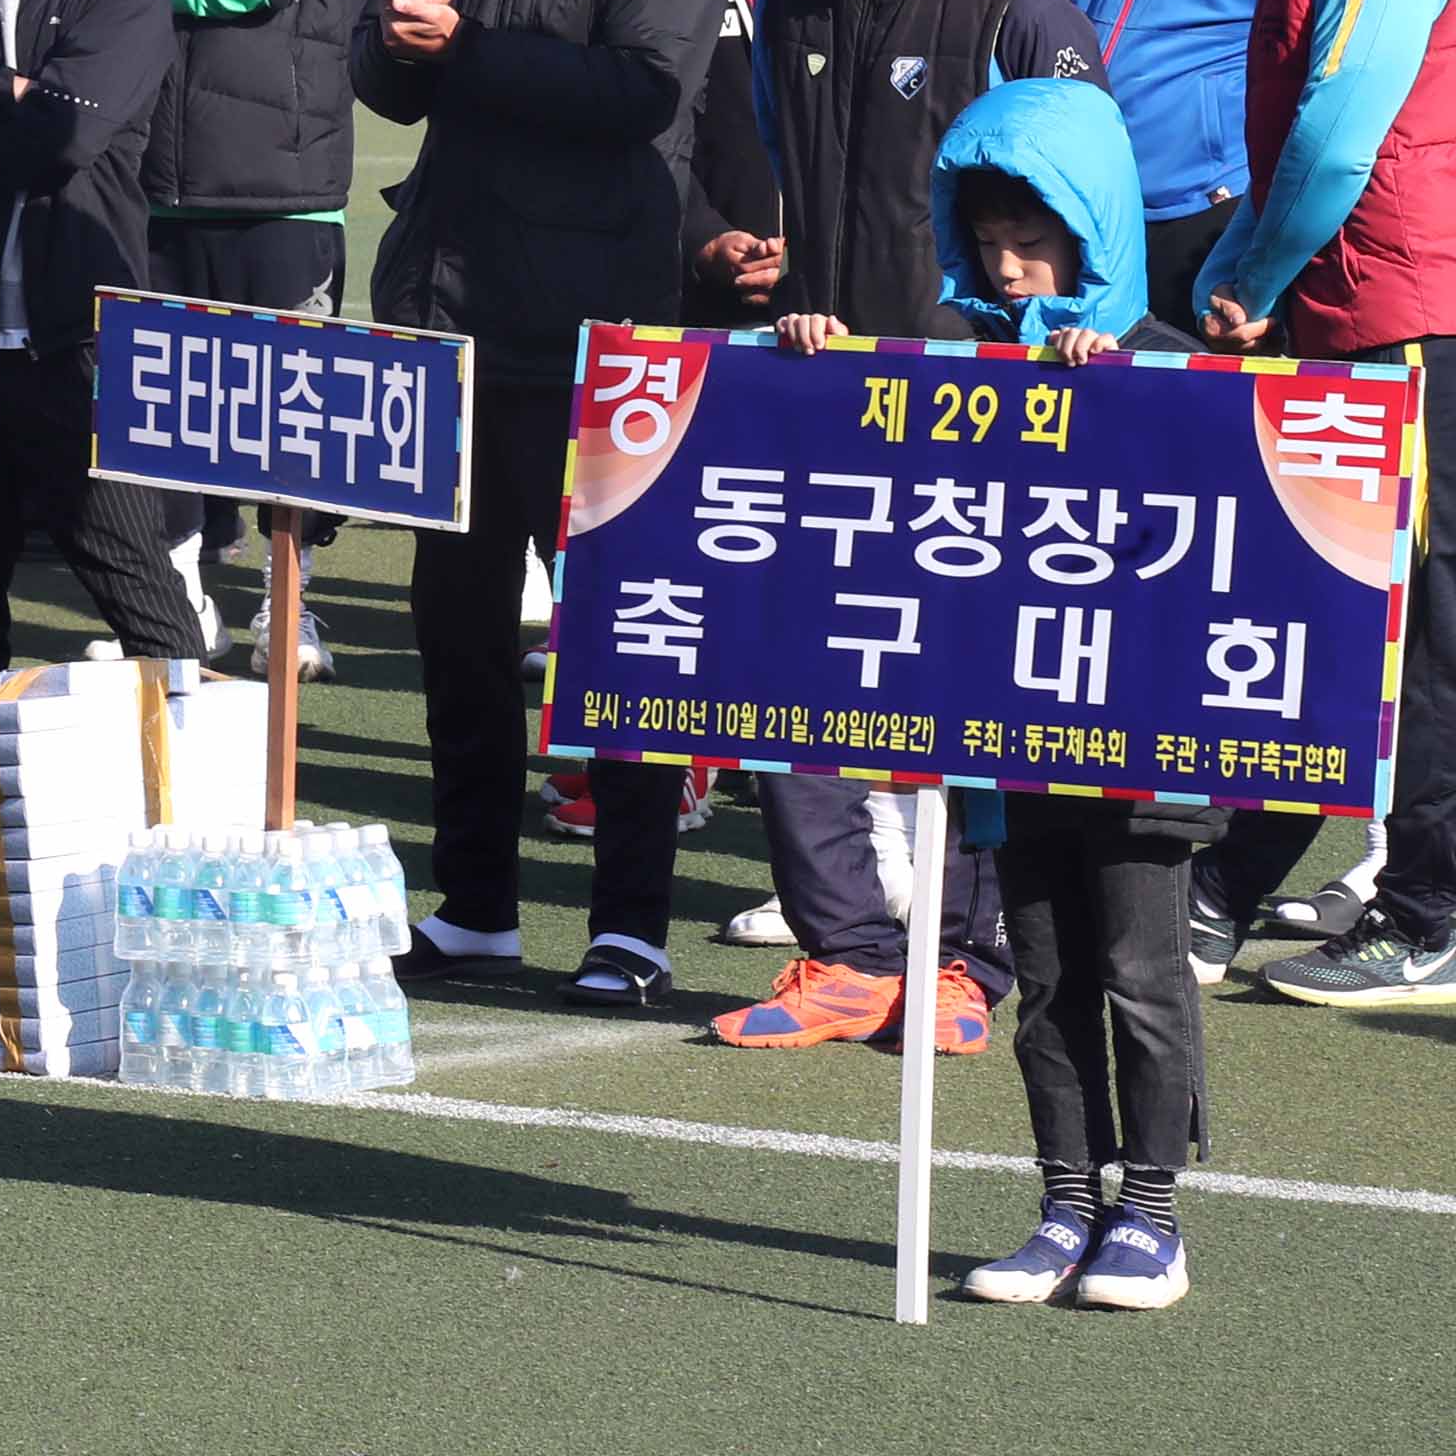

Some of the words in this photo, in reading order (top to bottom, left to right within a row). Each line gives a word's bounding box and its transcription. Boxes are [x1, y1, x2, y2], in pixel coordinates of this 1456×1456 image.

[128, 328, 427, 494] 로타리축구회
[592, 353, 681, 456] 경
[860, 377, 909, 443] 제
[930, 382, 999, 443] 29
[1020, 383, 1073, 453] 회
[1277, 392, 1386, 502] 축
[695, 465, 1237, 594] 동구청장기
[638, 696, 707, 736] 2018년
[716, 702, 758, 740] 10월
[764, 705, 814, 746] 21일,
[822, 709, 935, 755] 28일(2일간)
[1024, 724, 1127, 768] 동구체육회
[1218, 739, 1346, 785] 동구축구협회
